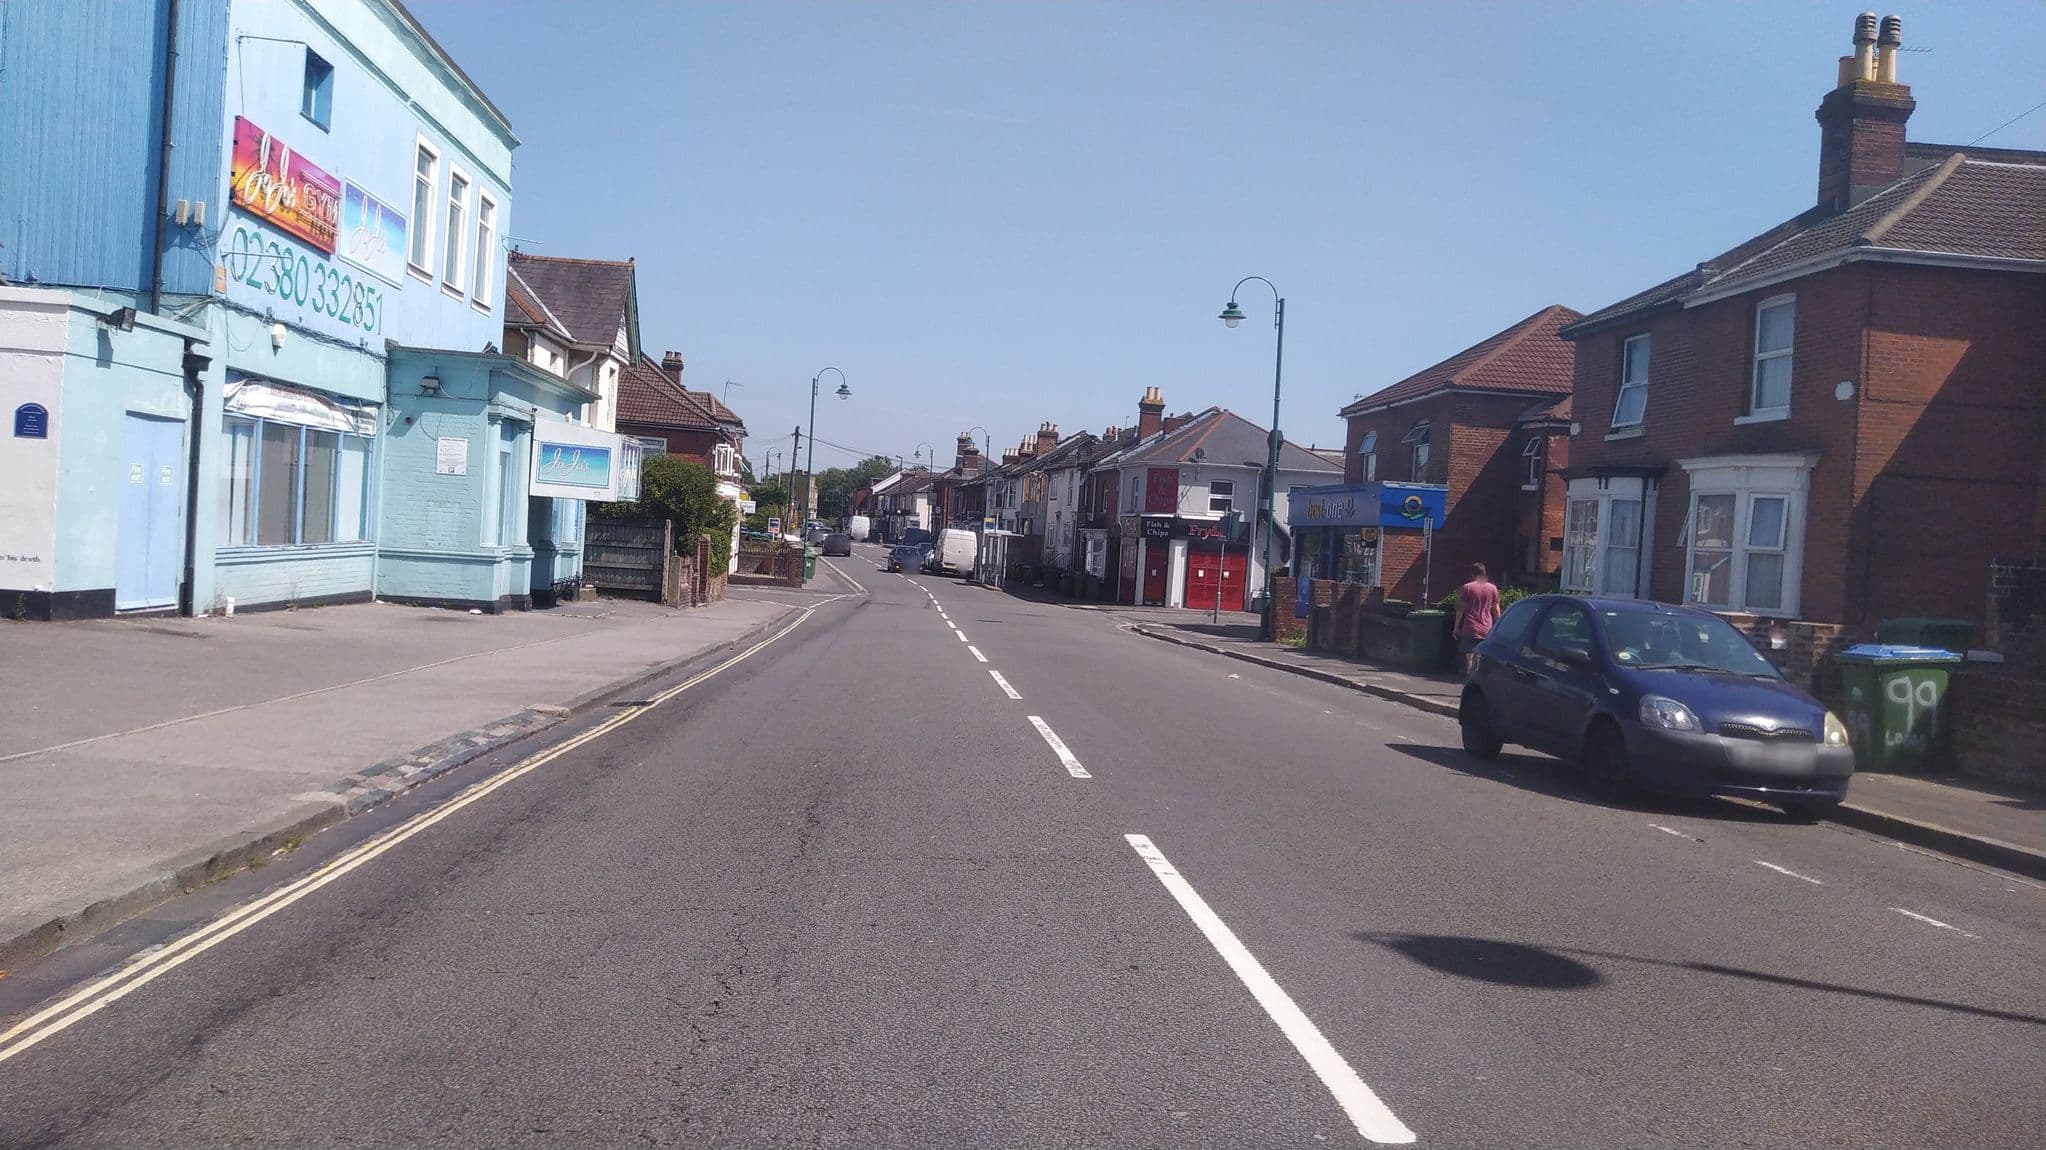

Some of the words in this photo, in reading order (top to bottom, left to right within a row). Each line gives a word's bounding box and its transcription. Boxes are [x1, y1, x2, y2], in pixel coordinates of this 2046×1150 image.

[303, 184, 341, 226] GYM
[542, 447, 590, 478] JoJo's
[1146, 520, 1162, 529] Fish
[1147, 529, 1169, 538] Chips
